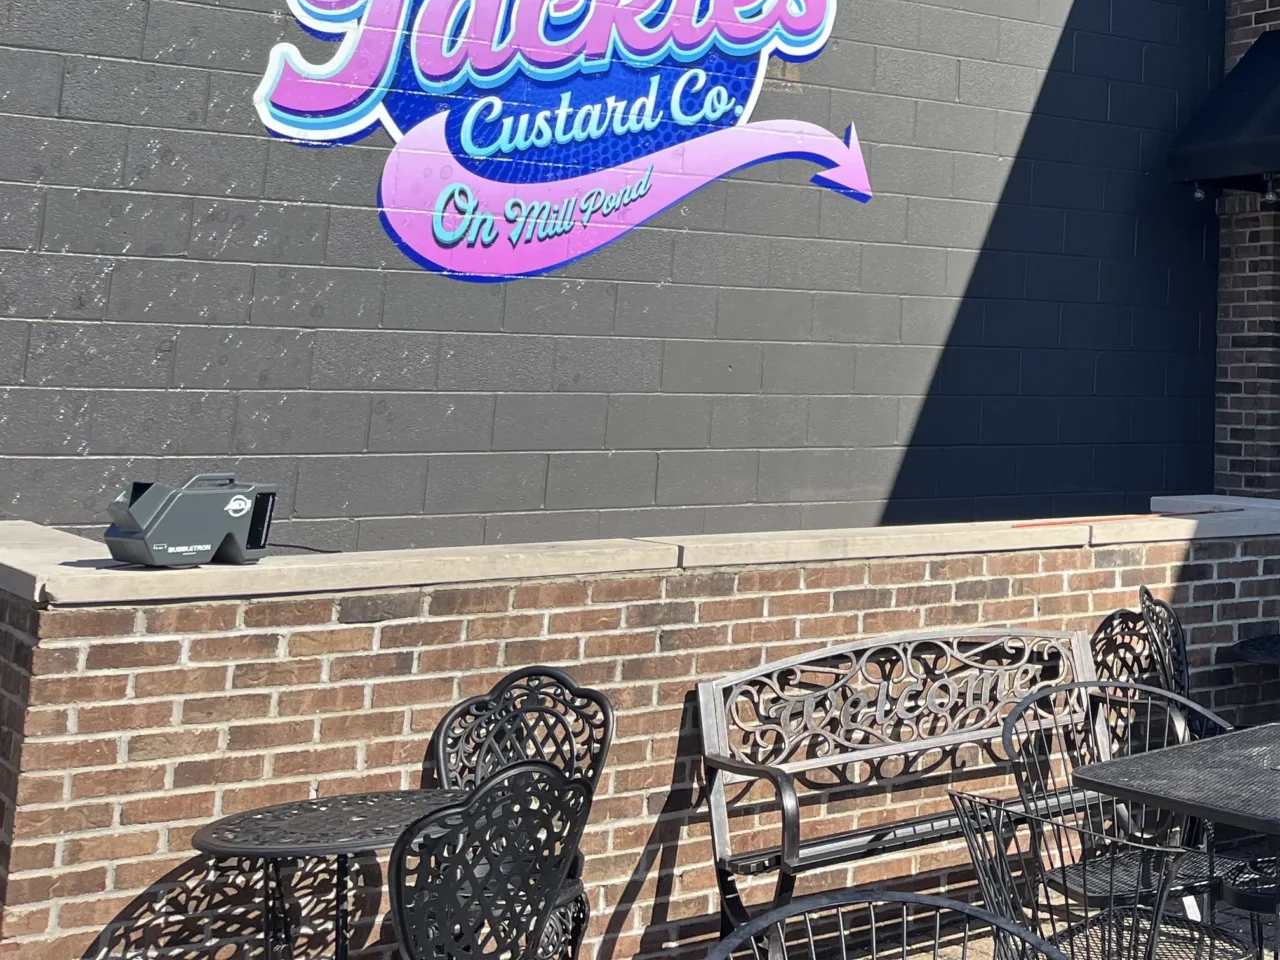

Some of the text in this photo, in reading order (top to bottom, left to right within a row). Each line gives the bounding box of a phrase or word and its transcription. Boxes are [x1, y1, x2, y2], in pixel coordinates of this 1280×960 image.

[461, 68, 743, 157] Custard Co.
[432, 164, 654, 249] On Mill Pond
[168, 544, 211, 553] BUBBLETRON
